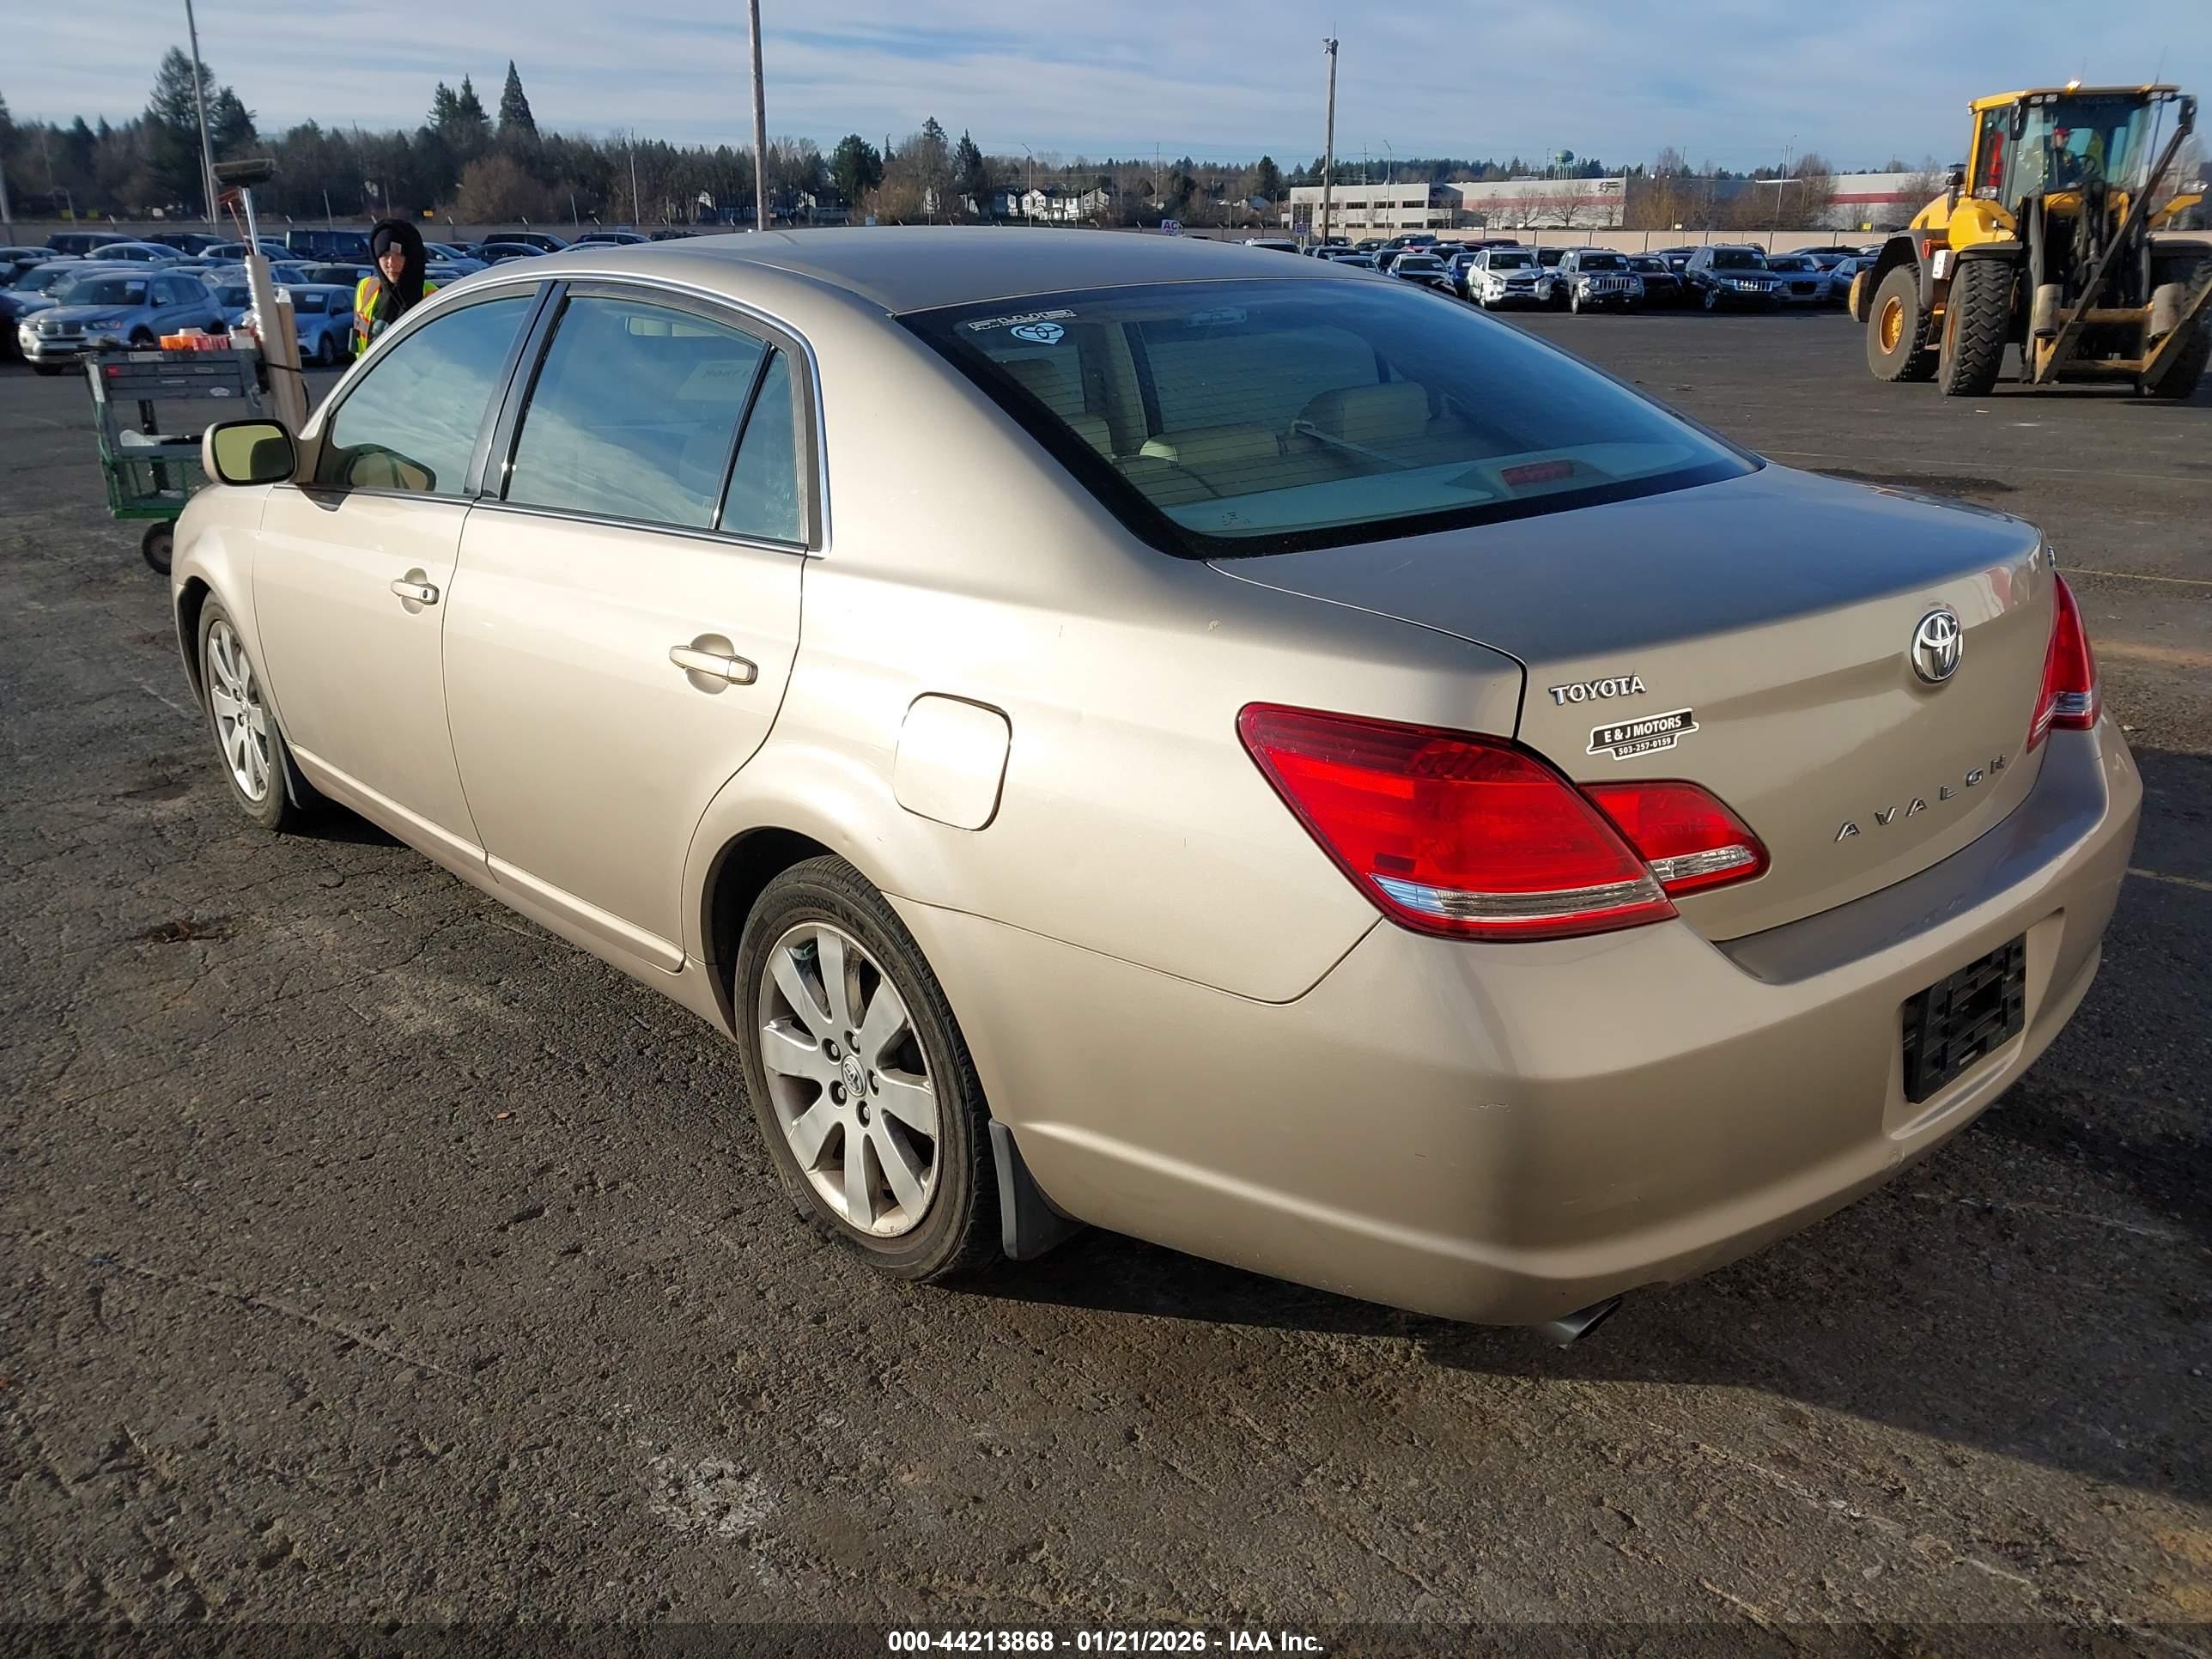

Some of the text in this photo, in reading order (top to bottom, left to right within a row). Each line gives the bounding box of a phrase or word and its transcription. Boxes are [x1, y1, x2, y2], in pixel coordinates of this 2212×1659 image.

[1164, 221, 1177, 230] AC
[1549, 674, 1646, 705] TOYOTA
[1604, 715, 1682, 743] E & J MOTORS
[1618, 737, 1672, 756] 503-257-0159
[1834, 755, 2007, 844] AVALON
